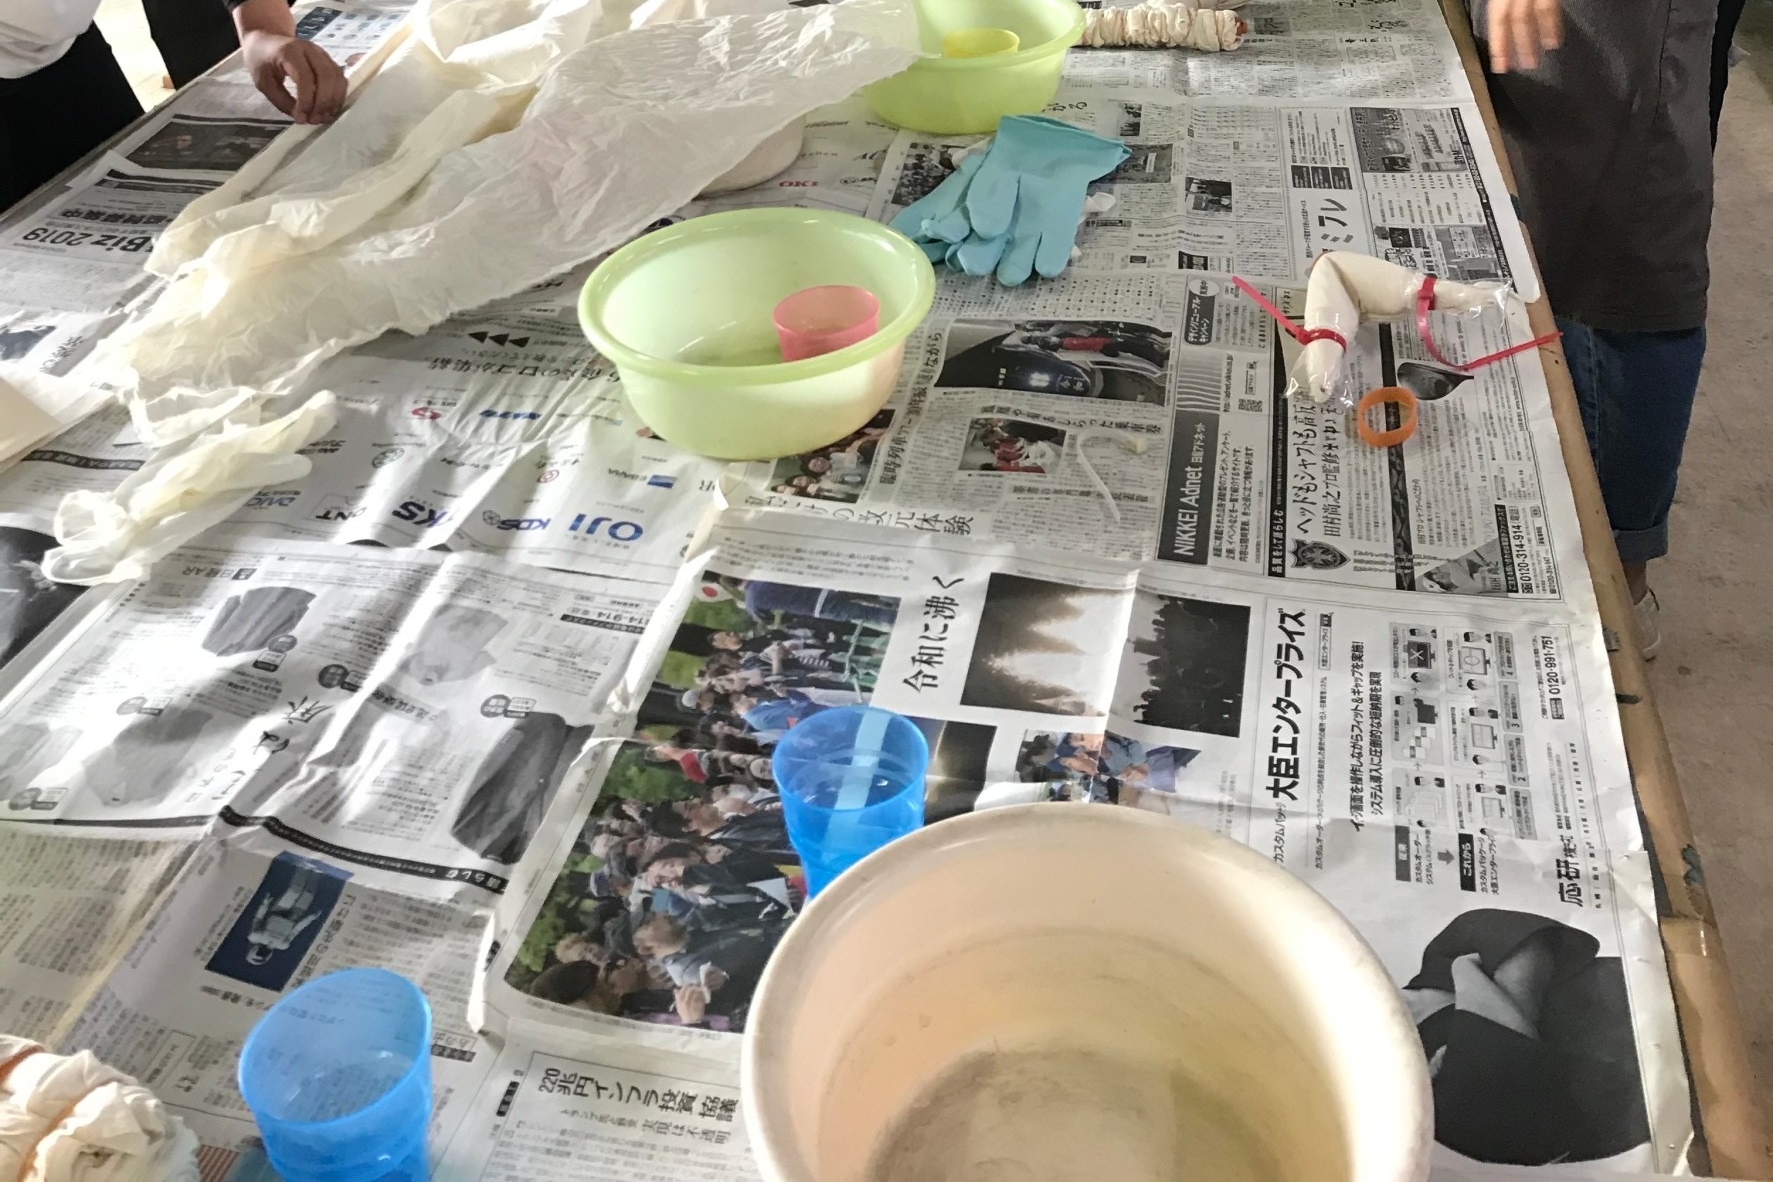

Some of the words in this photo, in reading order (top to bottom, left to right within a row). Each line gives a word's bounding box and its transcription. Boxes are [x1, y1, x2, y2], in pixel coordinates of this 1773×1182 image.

[22, 227, 93, 248] 2019
[91, 234, 153, 254] Biz
[1181, 466, 1203, 504] Adnet
[496, 518, 551, 531] KDS
[568, 513, 644, 542] OJI
[1174, 510, 1199, 556] NIKKEI
[1511, 524, 1532, 582] 0120-314-914
[902, 574, 965, 693] 令和に沸く
[1266, 608, 1306, 800] 大臣エンタープライズ
[1369, 672, 1383, 816] システム導入に圧倒的な短納期を実現
[1413, 833, 1423, 884] カスタムオーダー
[1462, 842, 1472, 877] これから
[1556, 858, 1583, 908] 応研
[640, 1118, 731, 1145] 実現は不透明
